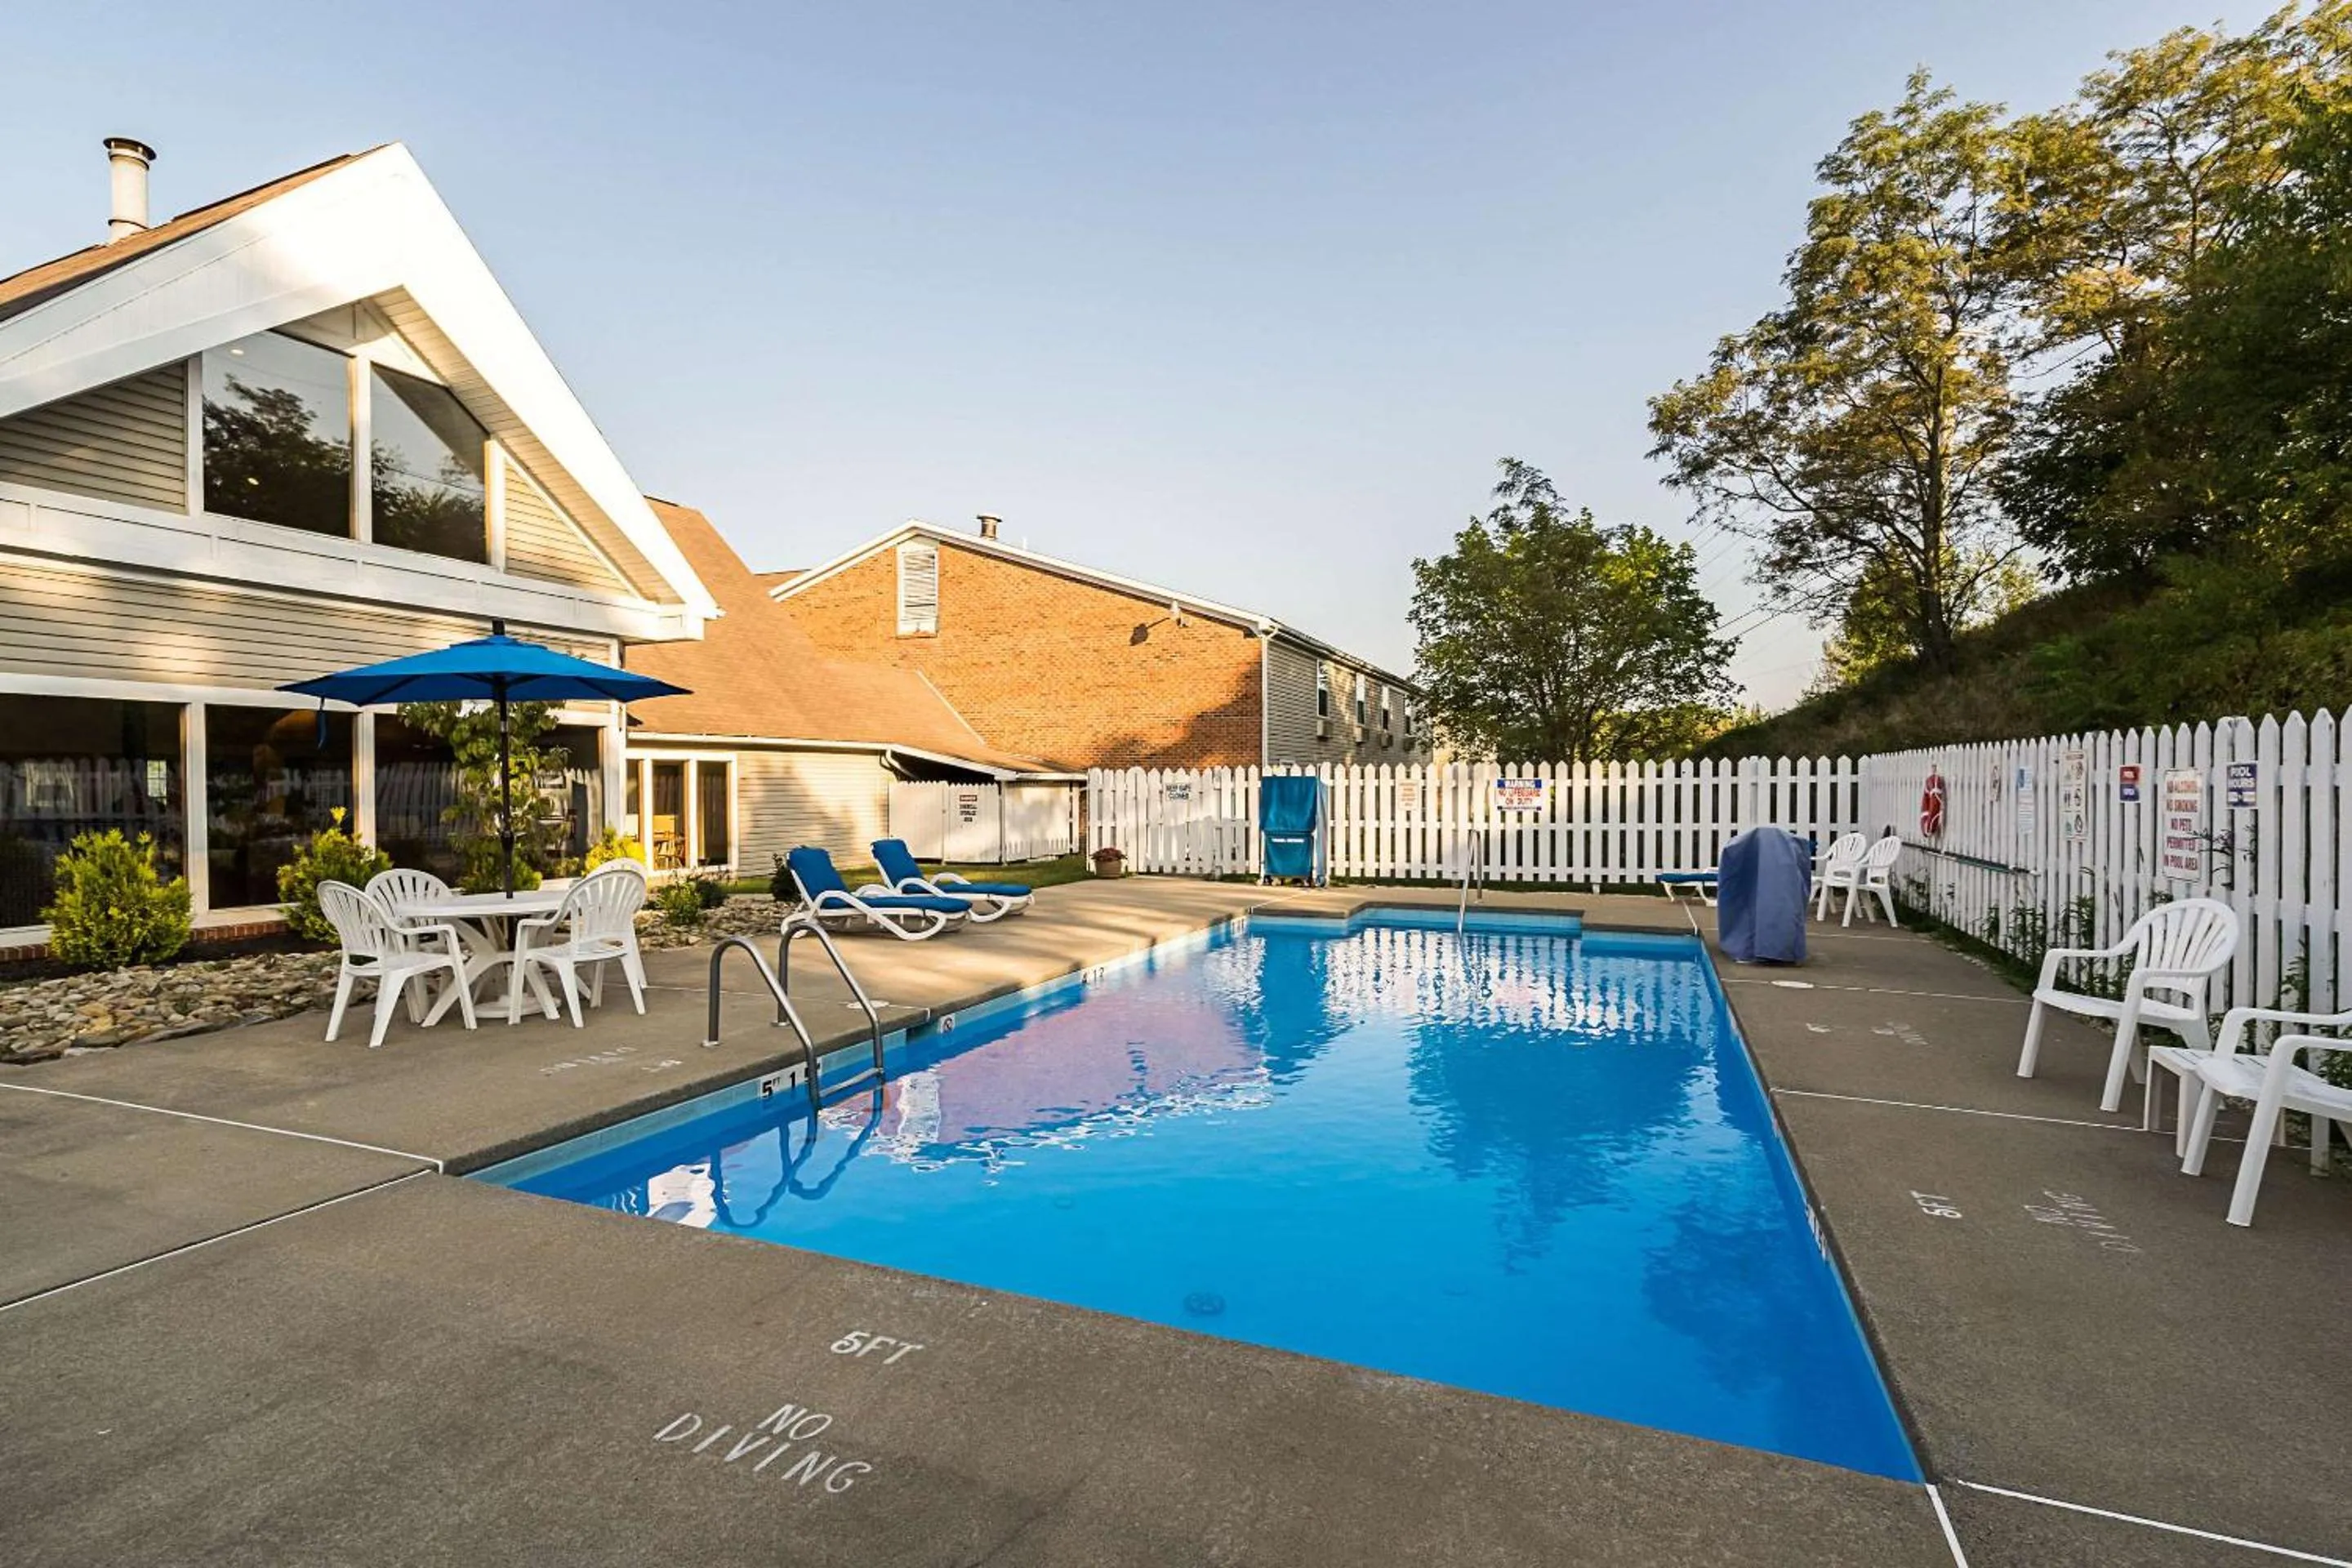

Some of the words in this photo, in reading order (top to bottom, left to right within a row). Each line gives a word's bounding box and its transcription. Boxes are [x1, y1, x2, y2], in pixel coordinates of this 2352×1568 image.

[2166, 799, 2174, 812] NO
[2174, 800, 2198, 813] SMOKING
[2171, 817, 2179, 831] NO
[830, 1330, 924, 1365] 5FT
[756, 1403, 833, 1441] NO
[653, 1412, 873, 1493] DIVING
